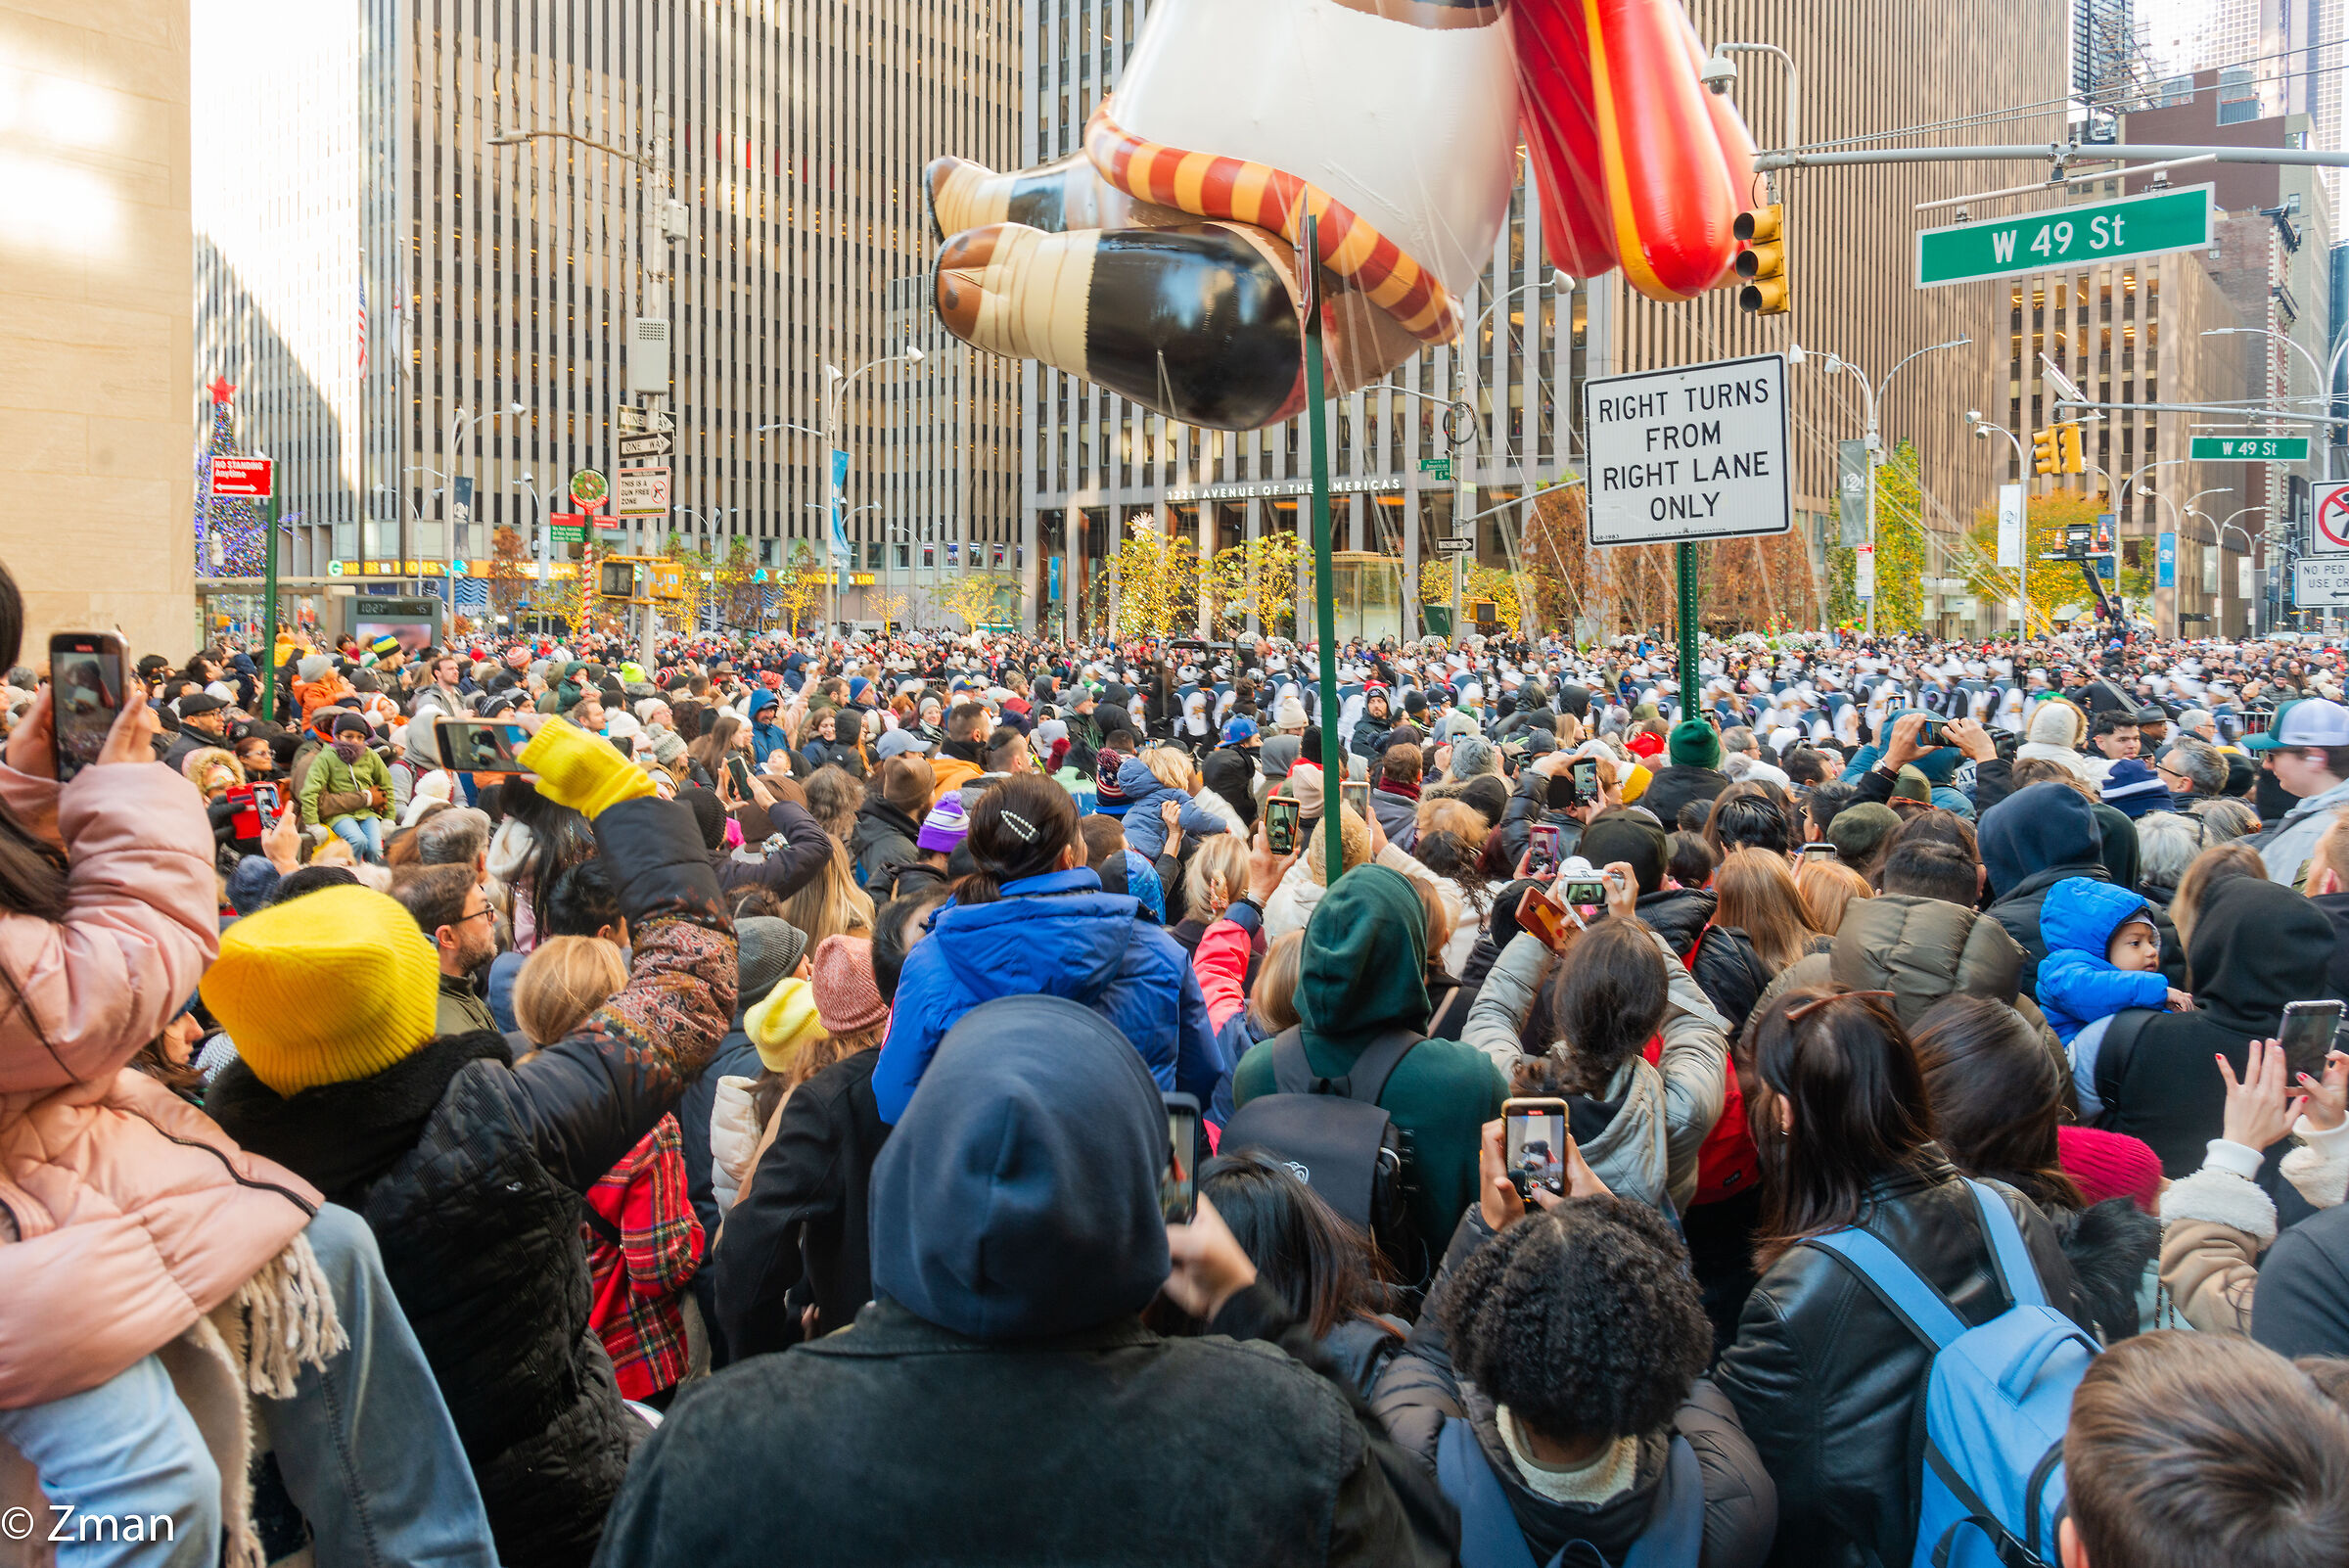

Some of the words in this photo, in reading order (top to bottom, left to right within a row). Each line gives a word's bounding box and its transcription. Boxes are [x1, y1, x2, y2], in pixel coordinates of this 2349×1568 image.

[1992, 229, 2017, 264] W
[2030, 221, 2074, 256] 49
[2089, 213, 2126, 251] St
[1599, 392, 1668, 423] RIGHT
[1684, 378, 1769, 412] TURNS
[626, 414, 643, 426] ONE
[1646, 420, 1721, 452] FROM
[626, 441, 642, 452] ONE
[648, 438, 666, 450] WAY
[2222, 441, 2234, 455] W
[2237, 441, 2257, 455] 49
[2262, 441, 2278, 455] St
[214, 460, 227, 470] NO
[226, 460, 264, 471] STANDING
[1603, 460, 1680, 491] RIGHT
[1693, 450, 1770, 483] LANE
[214, 469, 247, 480] Anytime
[1168, 490, 1196, 500] 1221
[1202, 486, 1255, 499] AVENUE
[1263, 484, 1280, 496] OF
[1288, 484, 1314, 494] THE
[1650, 491, 1721, 522] ONLY
[2303, 565, 2319, 575] NO
[2308, 578, 2329, 588] USE
